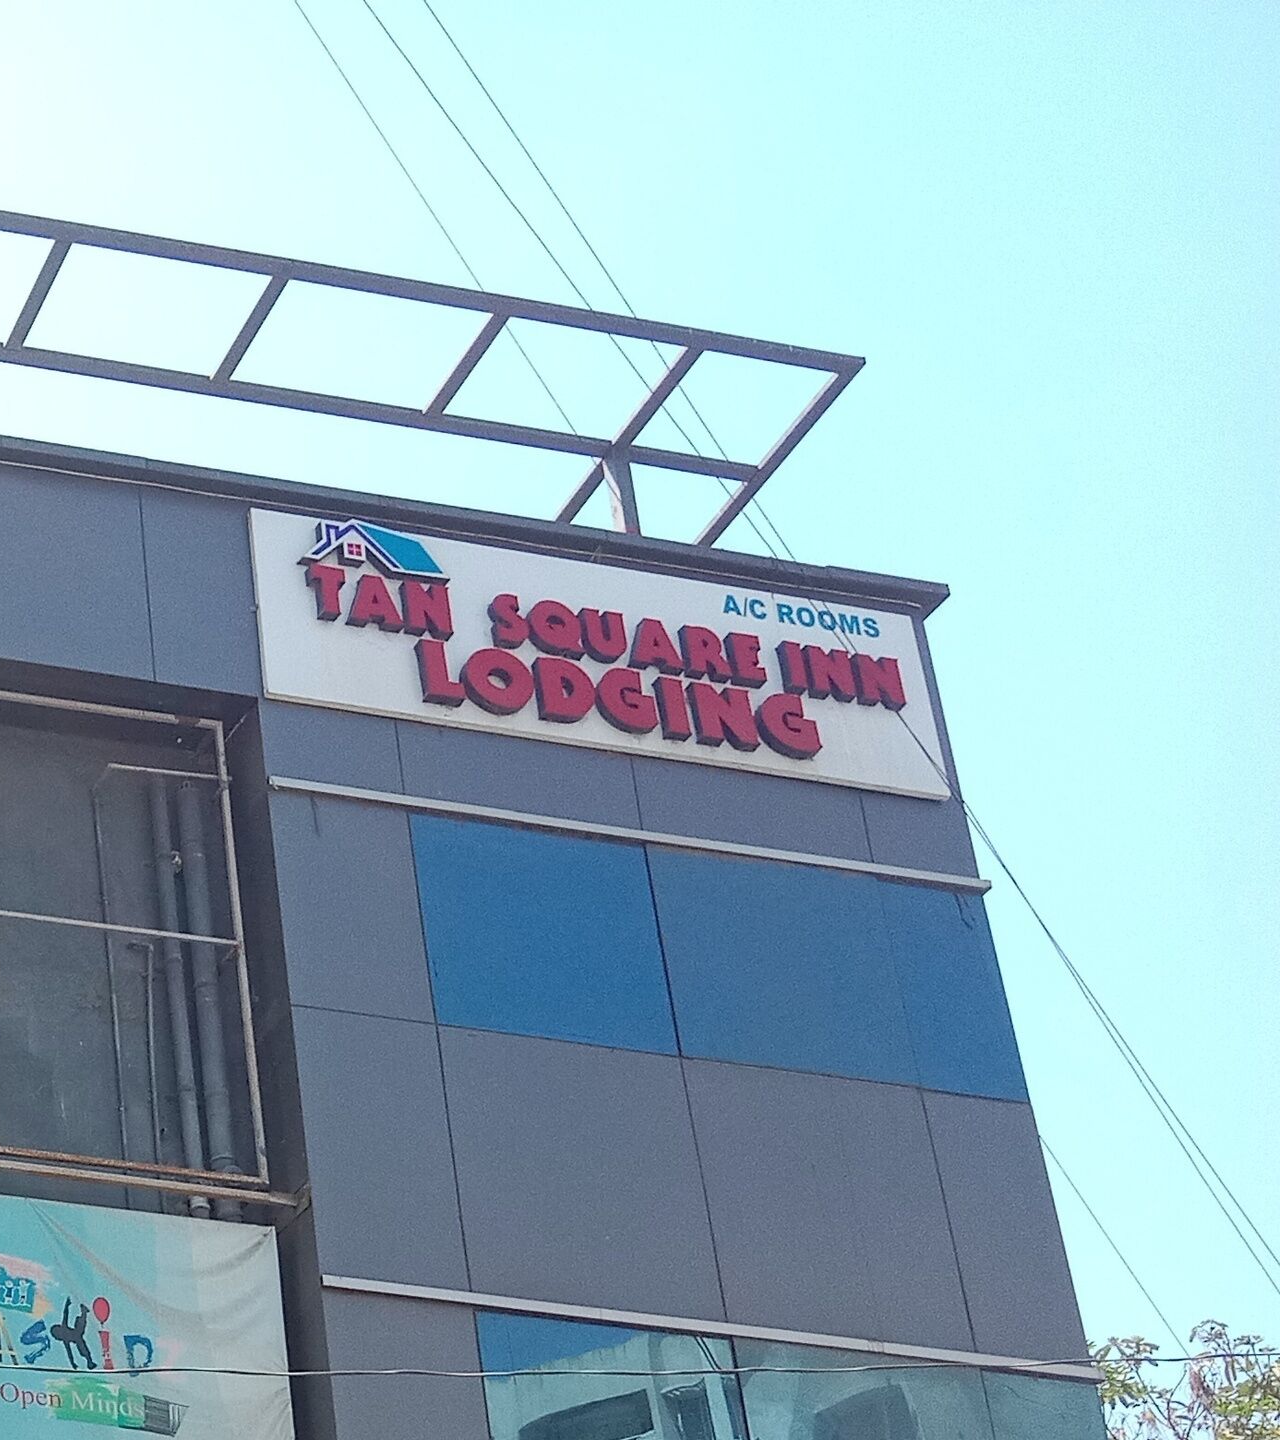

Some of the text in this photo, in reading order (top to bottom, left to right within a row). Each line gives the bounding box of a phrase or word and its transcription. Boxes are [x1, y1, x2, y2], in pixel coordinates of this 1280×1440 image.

[305, 564, 907, 712] TAN SQUARE INN
[722, 594, 881, 640] A/C ROOMS
[414, 638, 823, 760] LODGING
[0, 1382, 63, 1410] Open
[71, 1390, 146, 1418] Minds
